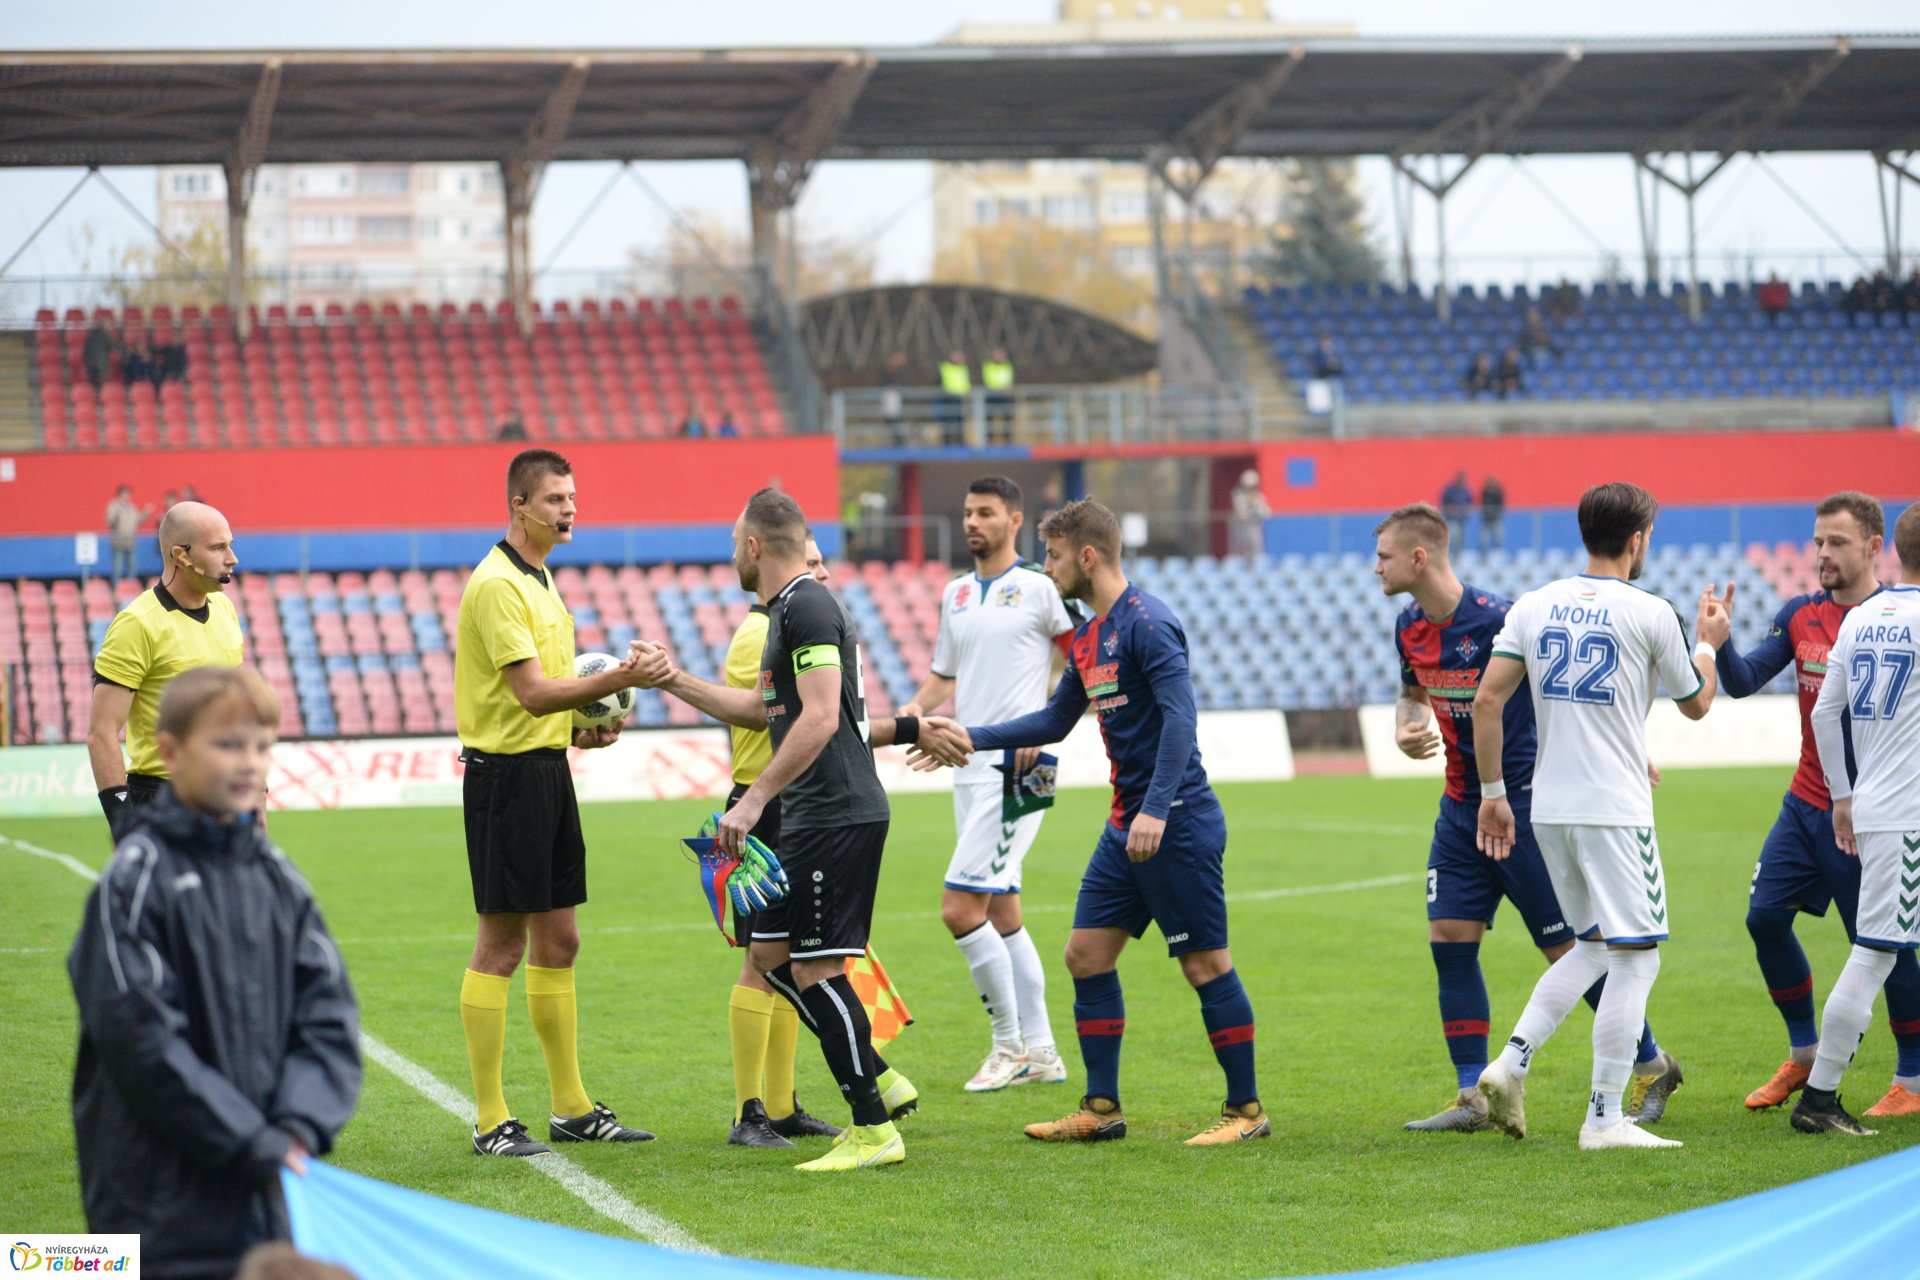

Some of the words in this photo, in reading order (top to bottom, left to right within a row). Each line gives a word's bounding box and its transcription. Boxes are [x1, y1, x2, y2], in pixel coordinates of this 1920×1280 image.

[1549, 604, 1612, 626] MOHL
[1855, 625, 1912, 643] VARGA
[796, 649, 813, 671] C
[1537, 626, 1620, 706] 22
[1851, 648, 1915, 720] 27
[1542, 922, 1565, 935] JAKO
[800, 937, 822, 947] JAKO
